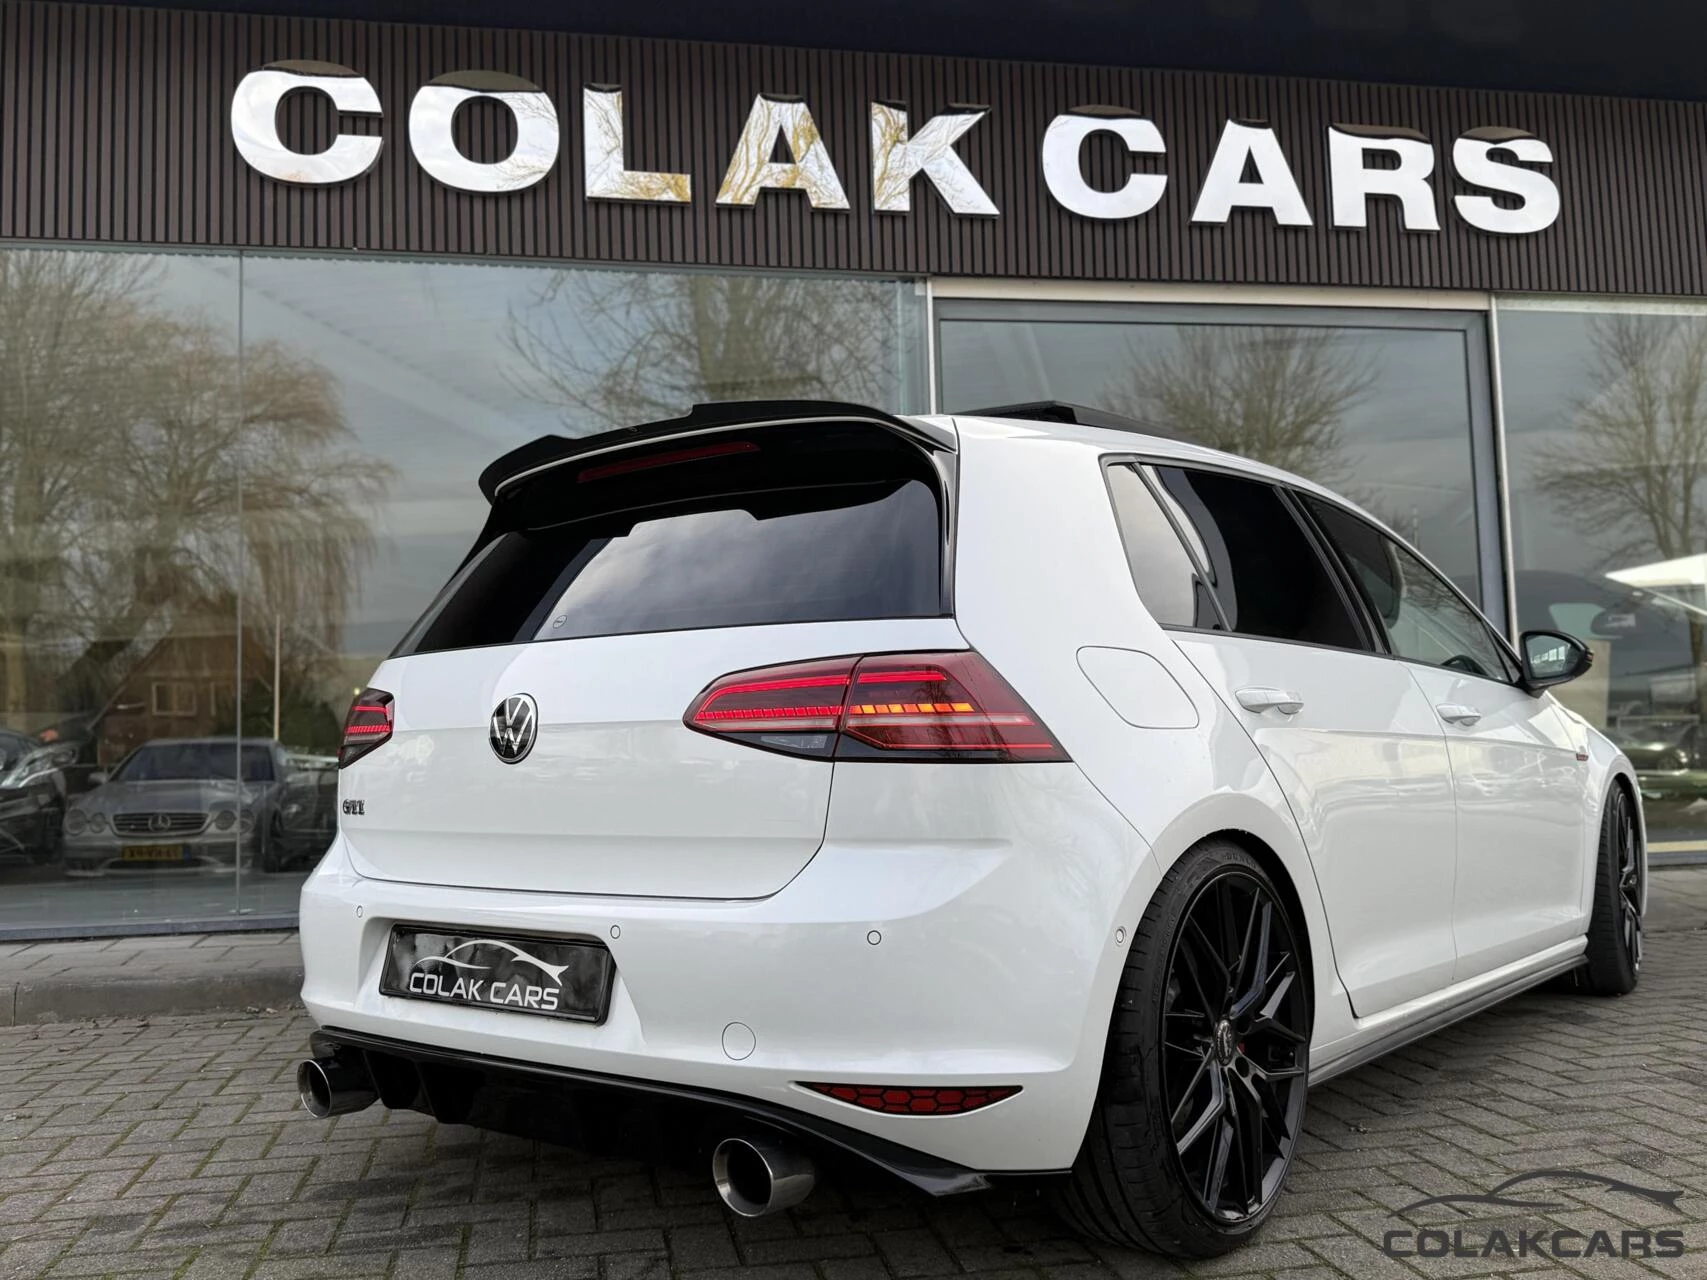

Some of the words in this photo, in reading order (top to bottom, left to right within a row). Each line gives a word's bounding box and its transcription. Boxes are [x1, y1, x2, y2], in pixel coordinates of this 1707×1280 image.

[230, 59, 1000, 218] COLAK
[1041, 104, 1561, 234] CARS
[409, 972, 484, 1001] COLAK
[489, 982, 560, 1010] CARS
